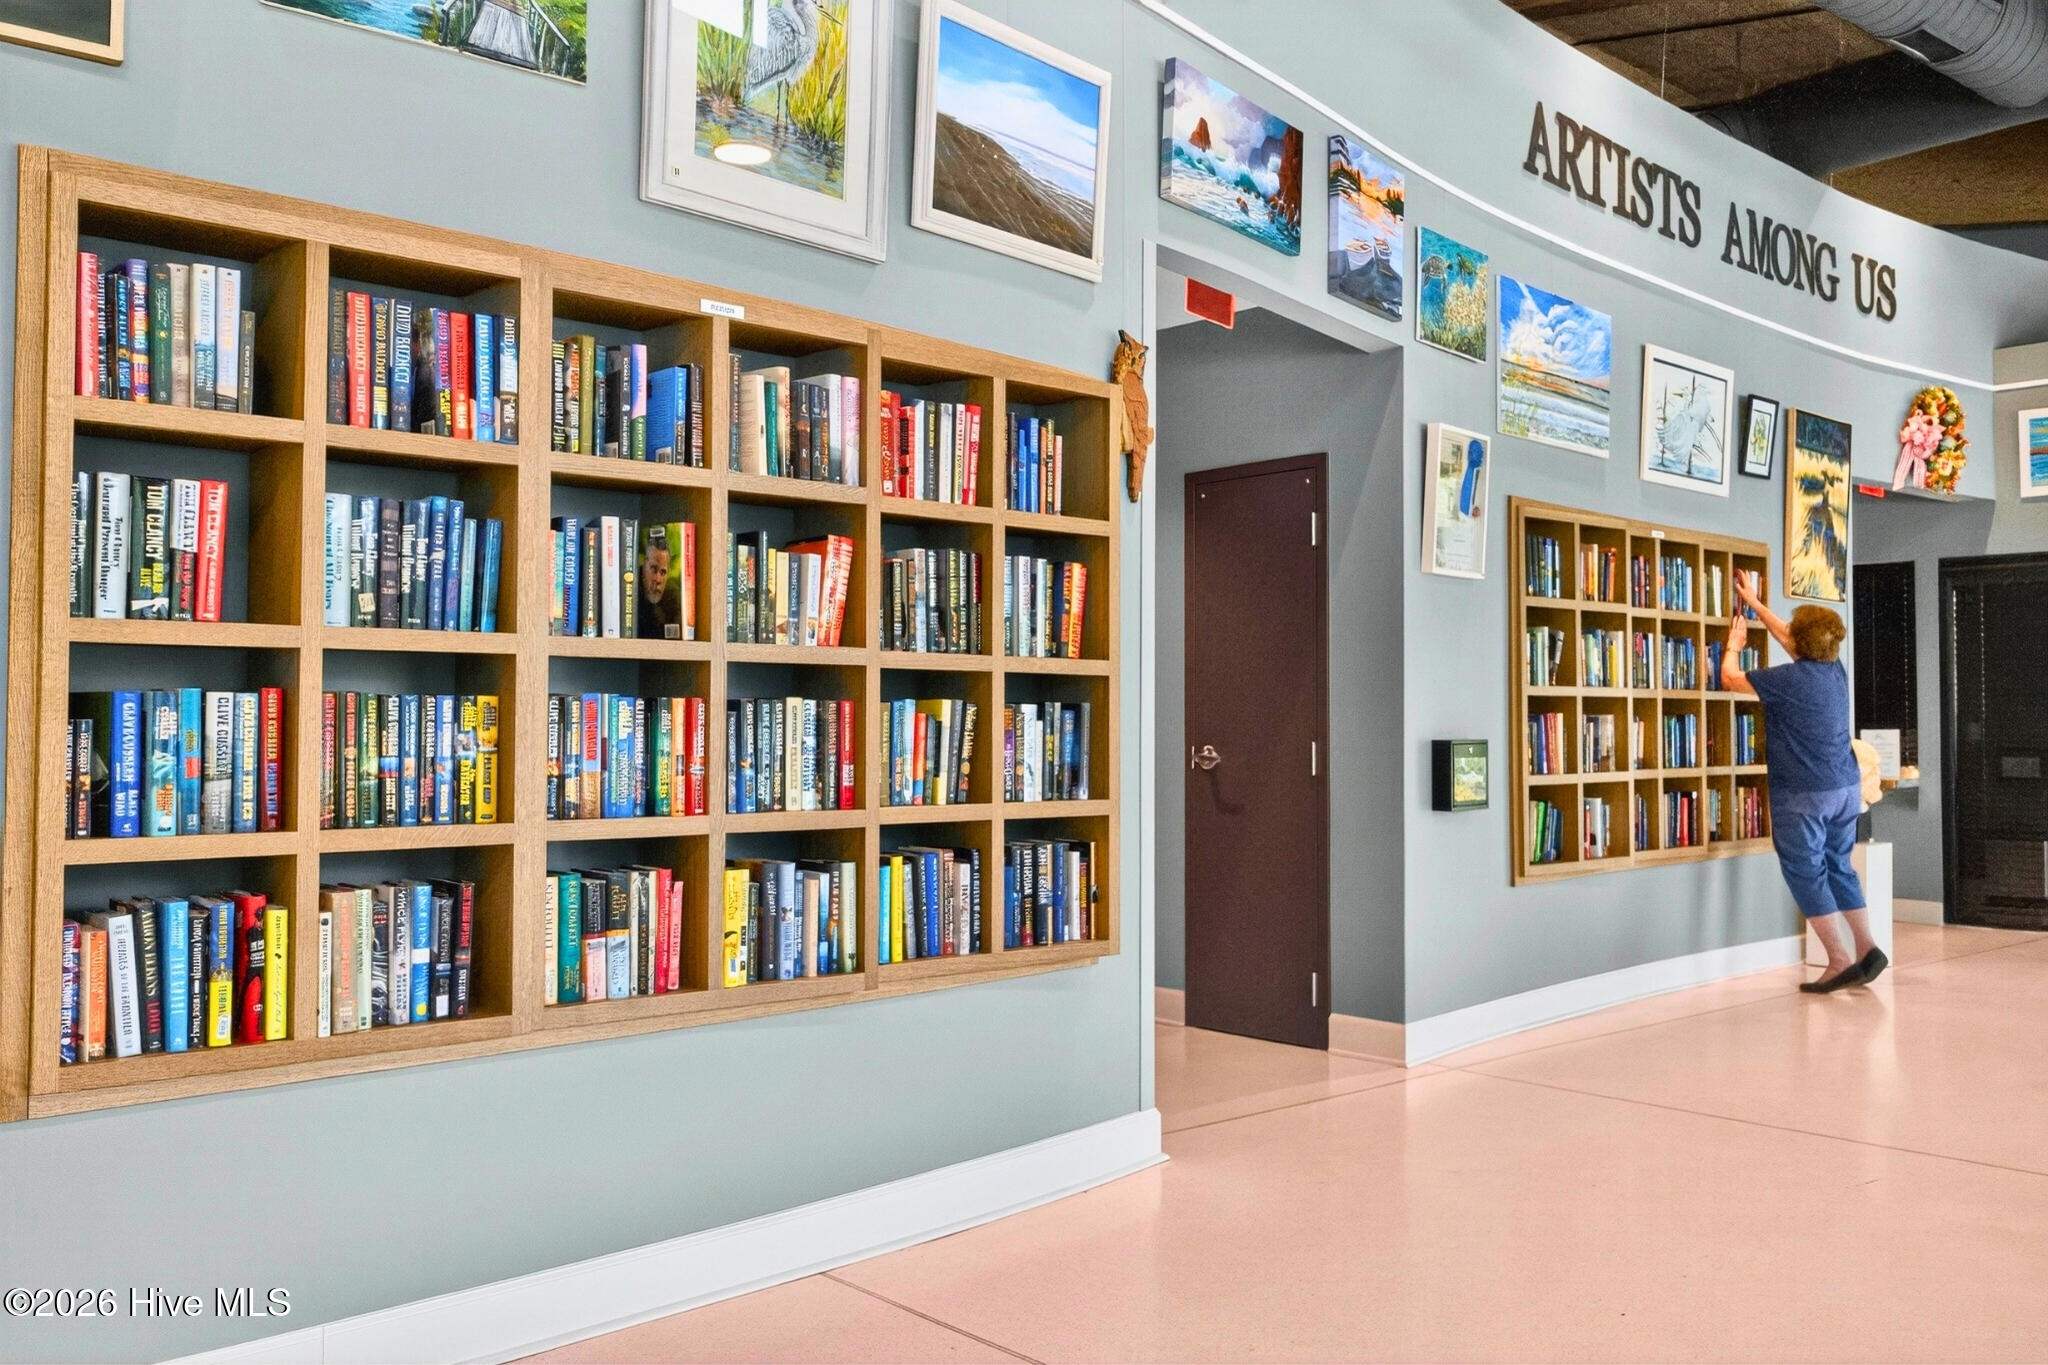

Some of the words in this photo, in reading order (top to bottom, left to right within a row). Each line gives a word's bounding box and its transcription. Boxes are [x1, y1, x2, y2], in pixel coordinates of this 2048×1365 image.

[1522, 100, 1701, 248] ARTISTS
[1720, 202, 1840, 302] AMONG
[1851, 253, 1897, 322] US
[146, 485, 165, 509] TOM
[208, 485, 223, 511] TOM
[100, 526, 111, 562] Present
[145, 514, 165, 560] CLANCY
[206, 514, 221, 560] CLANCY
[99, 564, 111, 600] Danger
[216, 697, 229, 727] CLIVE
[396, 891, 407, 924] VINCE
[140, 911, 154, 951] AARON
[144, 954, 158, 997] ELKINS
